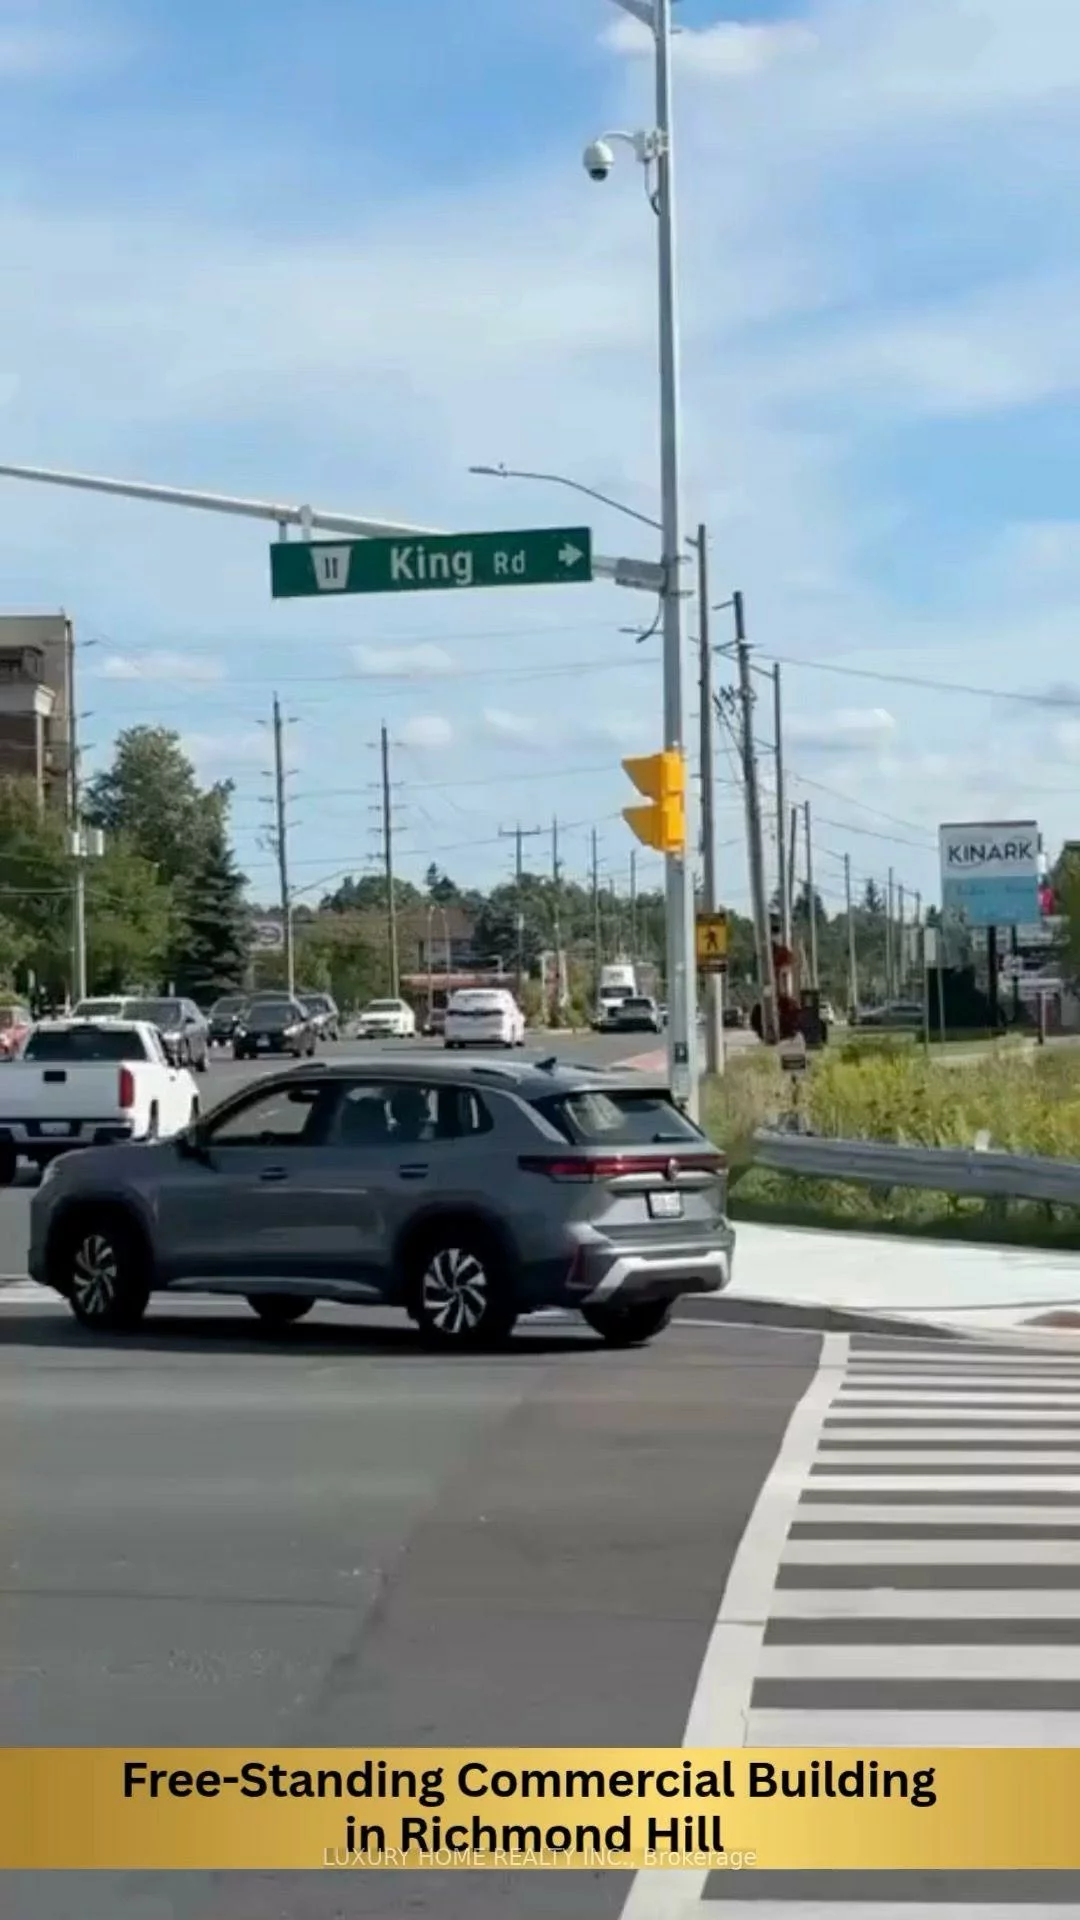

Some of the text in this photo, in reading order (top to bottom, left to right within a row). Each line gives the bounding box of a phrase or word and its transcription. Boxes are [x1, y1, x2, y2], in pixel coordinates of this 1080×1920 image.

[390, 545, 473, 586] King
[493, 549, 526, 575] Rd
[948, 841, 1034, 864] KINARK
